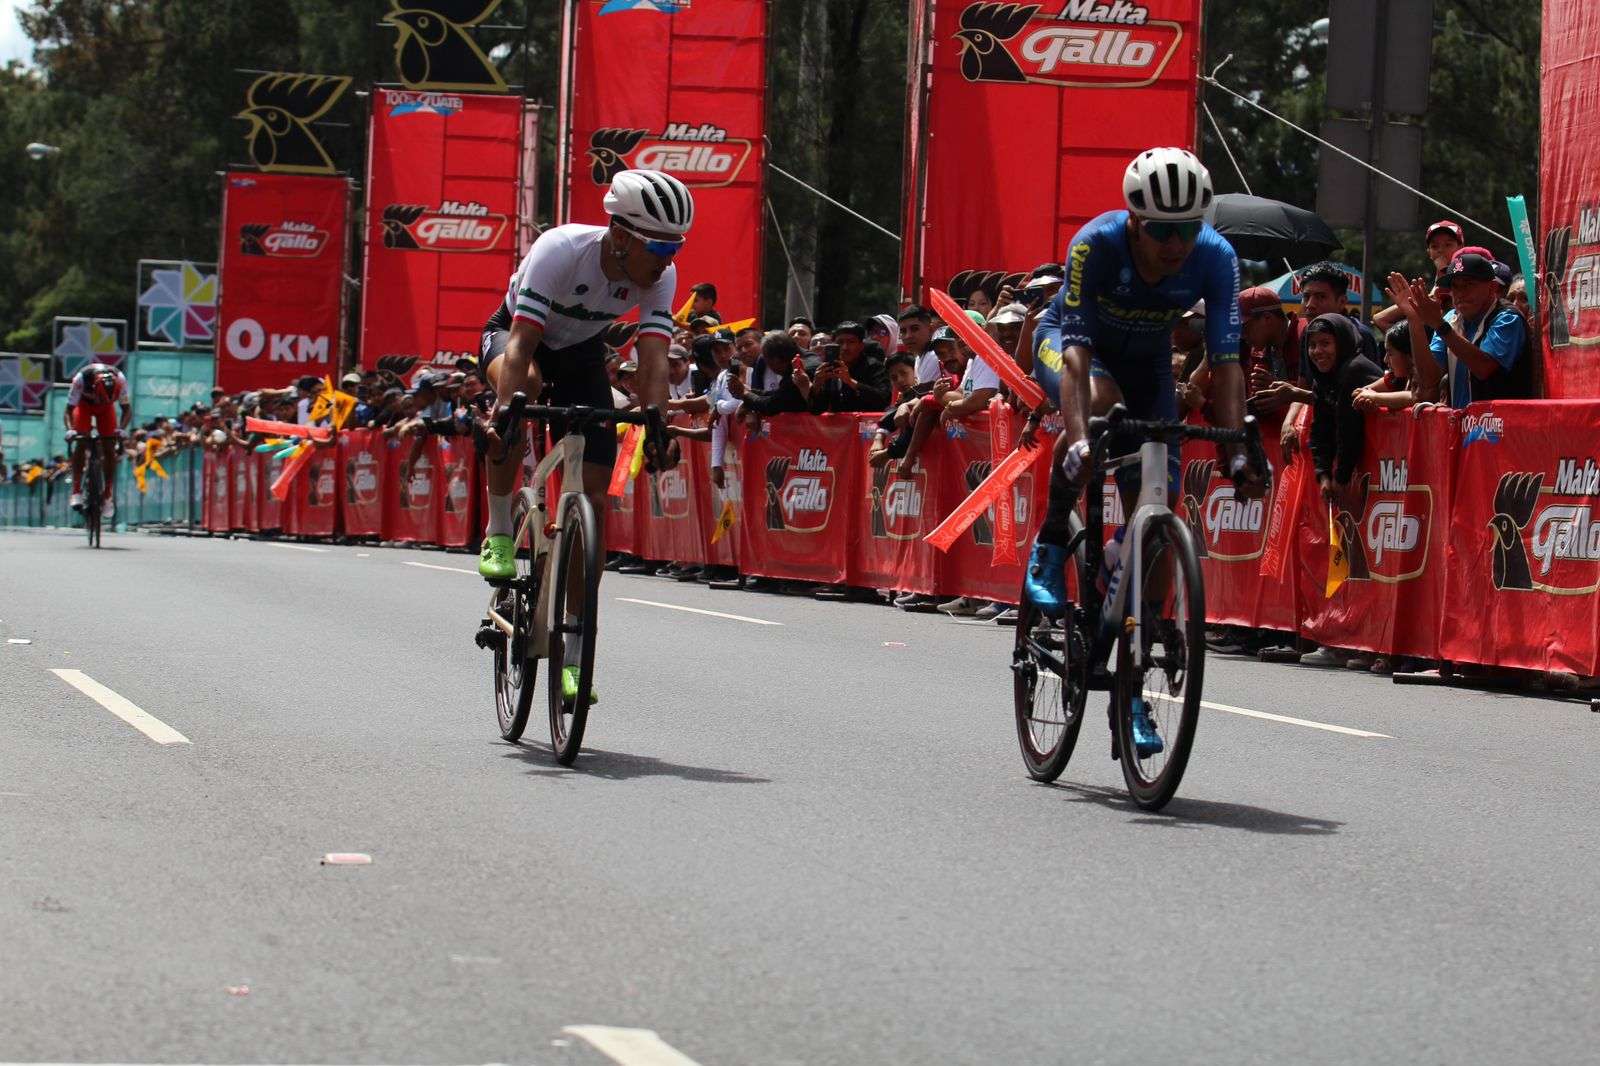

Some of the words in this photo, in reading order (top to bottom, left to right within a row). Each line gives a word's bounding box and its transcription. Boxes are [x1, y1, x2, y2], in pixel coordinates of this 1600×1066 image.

[1056, 0, 1148, 25] Malta
[1021, 27, 1155, 74] Gallo
[661, 122, 726, 142] Malta
[635, 145, 732, 173] Gallo
[439, 200, 488, 216] Malta
[281, 220, 316, 233] Malta
[417, 217, 492, 245] Gallo
[1578, 207, 1600, 245] Mal
[264, 232, 319, 252] Gallo
[225, 317, 265, 361] 0
[269, 333, 329, 363] KM
[797, 448, 828, 471] Malta
[783, 477, 828, 520] Gallo
[1206, 486, 1263, 545] Gallo
[1532, 504, 1600, 576] Gallo
